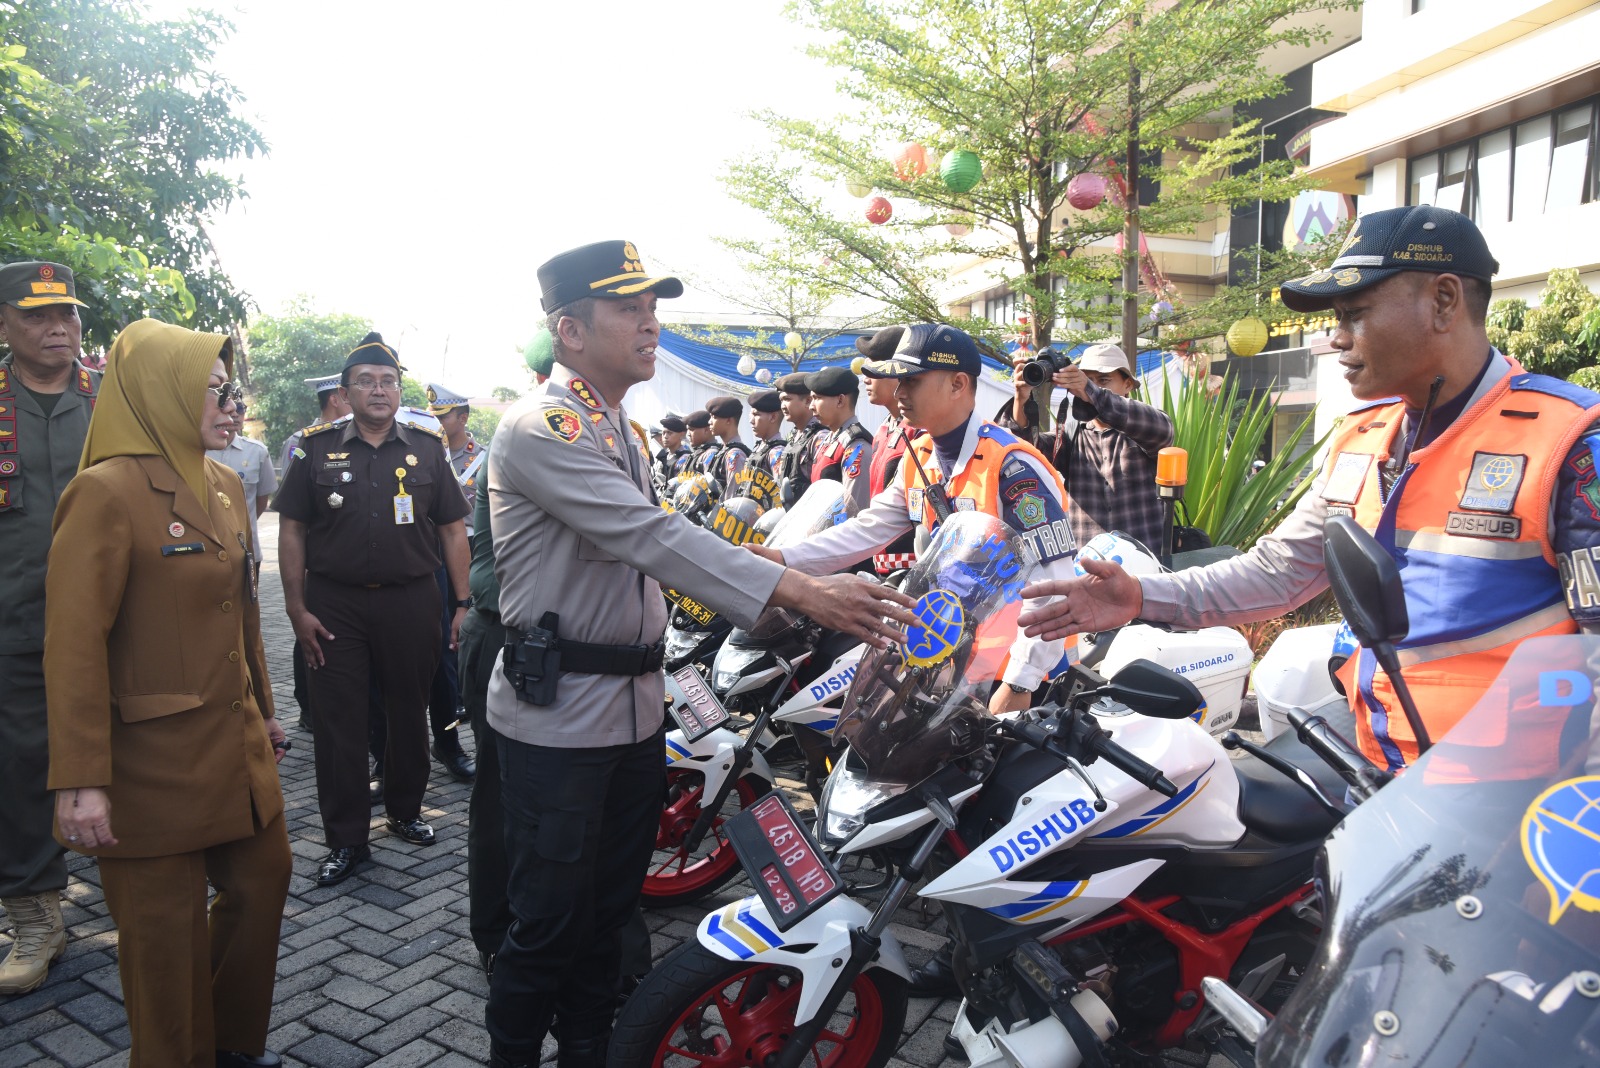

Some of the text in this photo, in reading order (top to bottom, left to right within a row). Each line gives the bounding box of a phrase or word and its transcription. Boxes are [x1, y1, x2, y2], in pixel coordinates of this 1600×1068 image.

[1292, 131, 1311, 152] JAW
[1407, 244, 1443, 252] DISHUB
[1414, 253, 1453, 261] SIDOARJO
[931, 351, 957, 360] DISHUB
[1449, 517, 1515, 534] DISHUB
[681, 597, 711, 623] 10216-31
[1171, 653, 1234, 675] AB.SIDOARJO
[684, 683, 708, 708] 4612
[988, 798, 1096, 874] DISHUB
[755, 801, 825, 894] W 4618 NP
